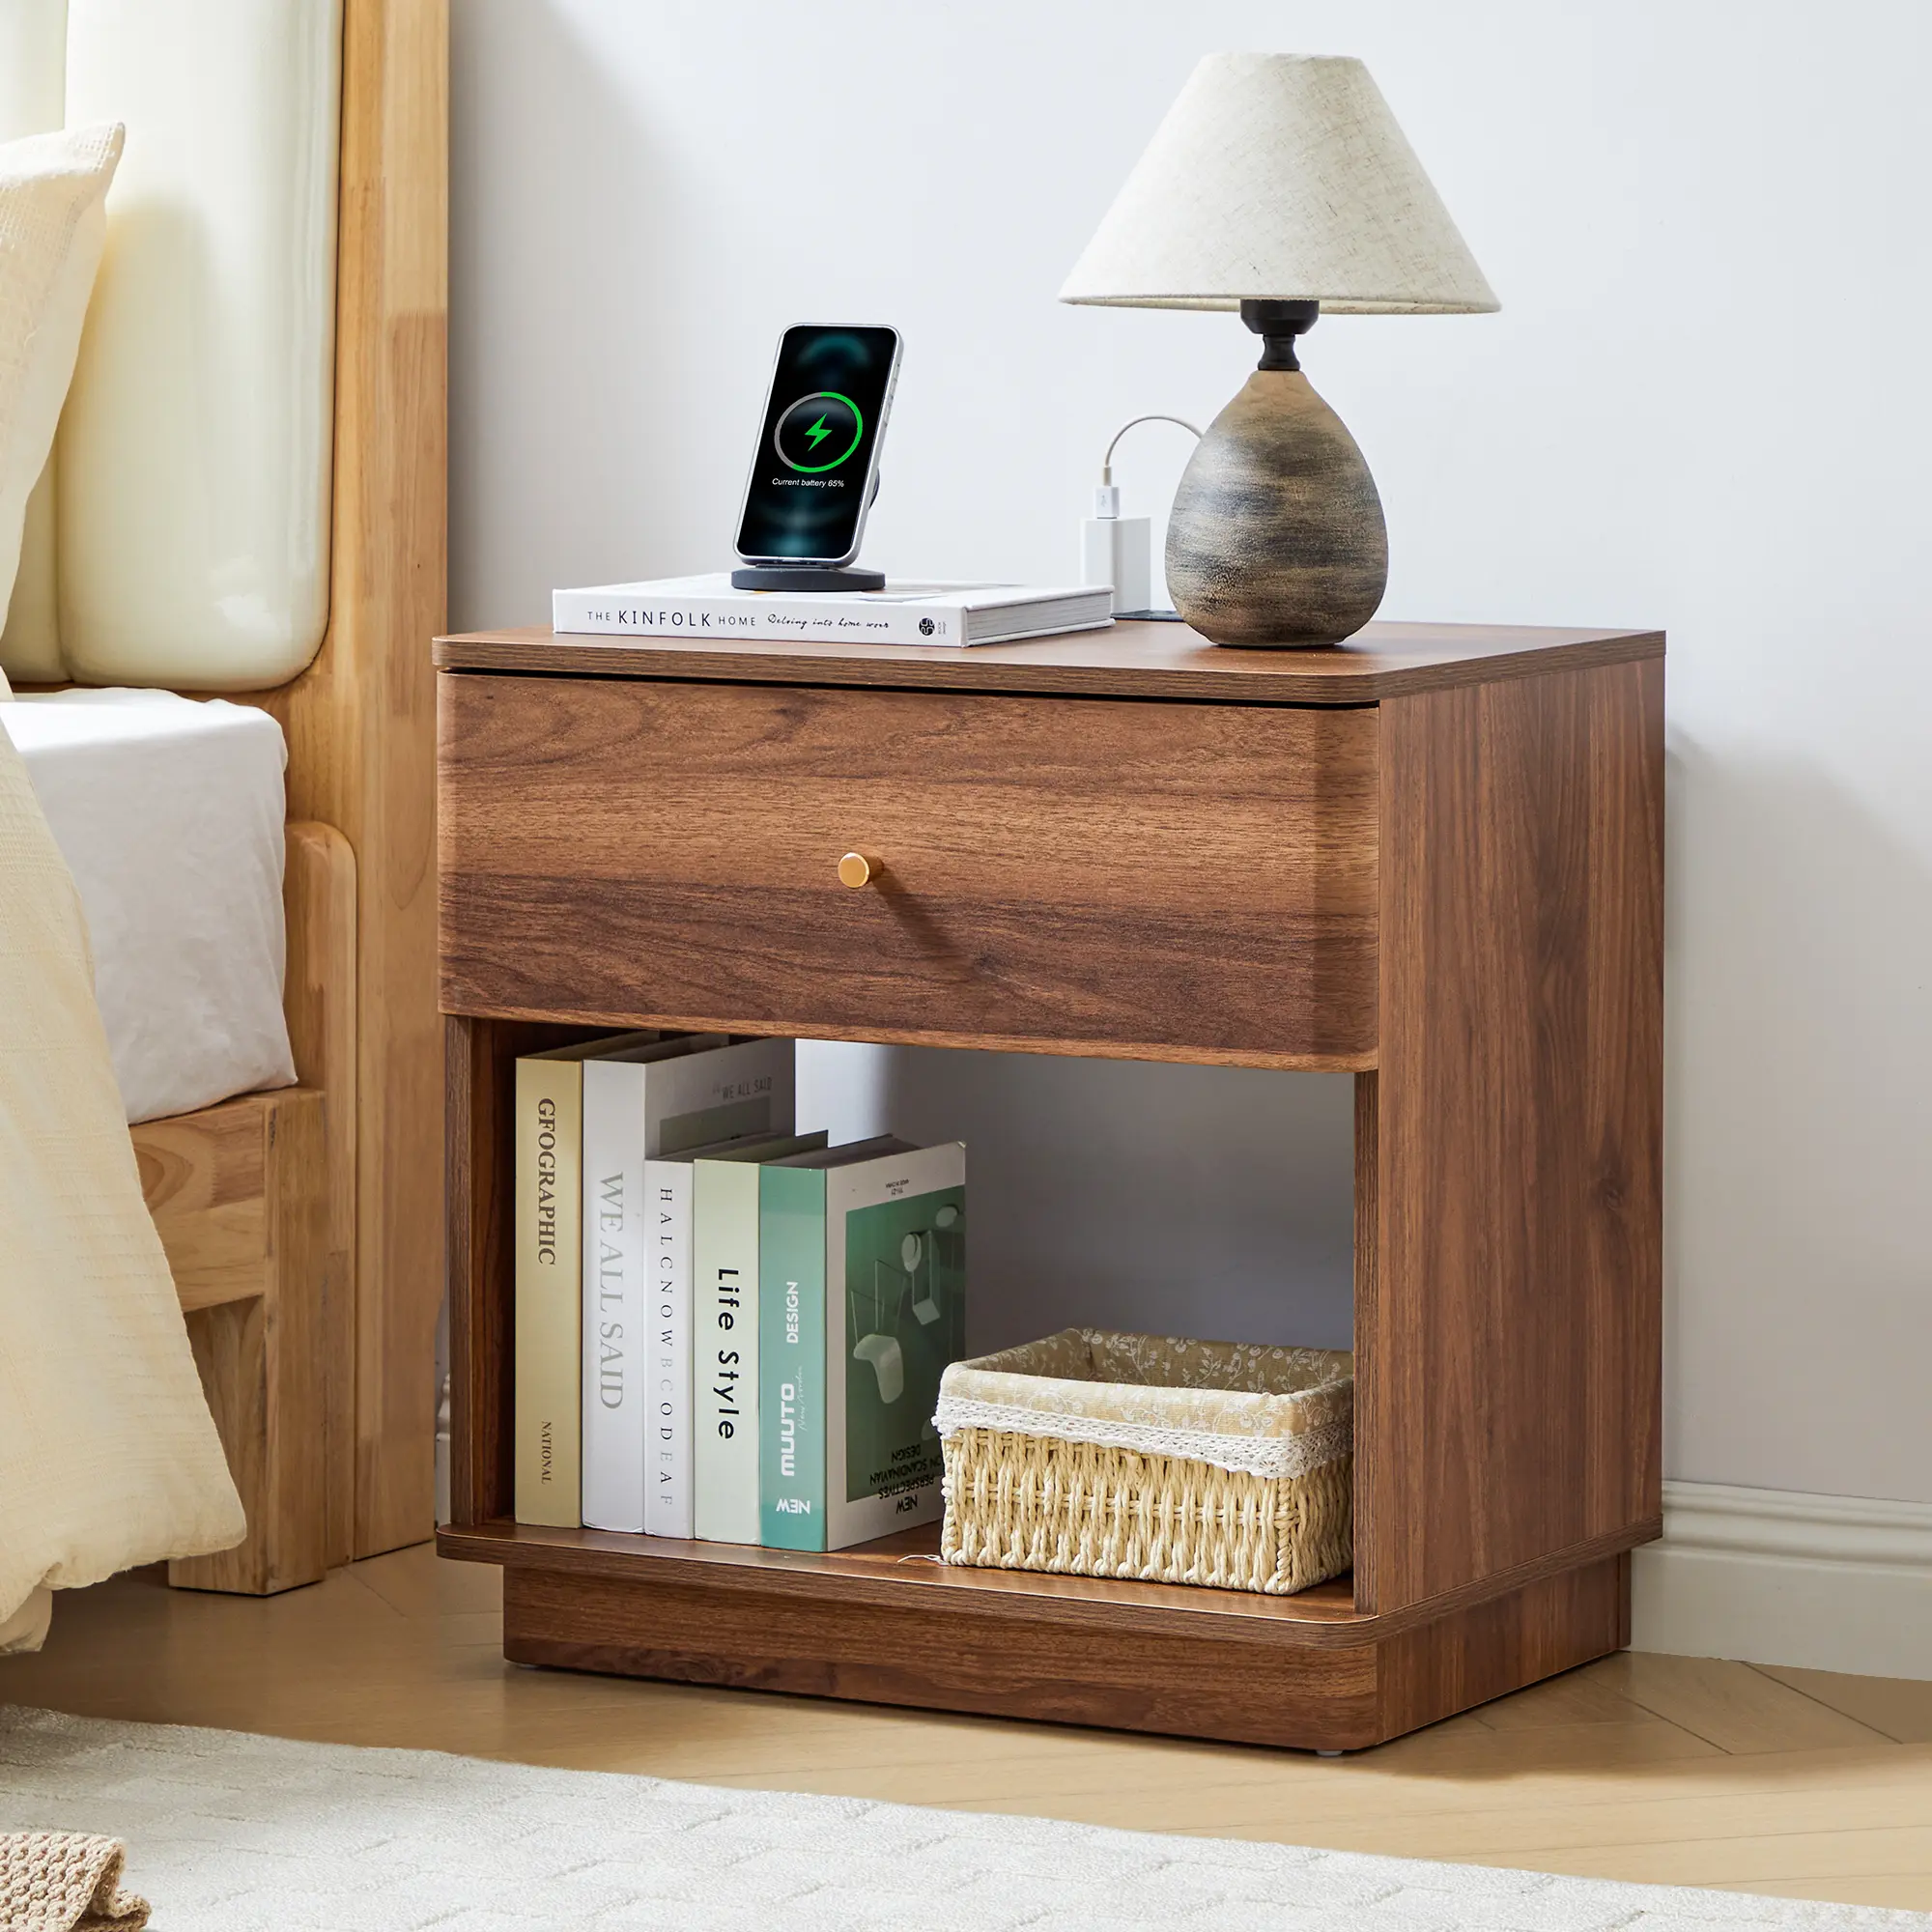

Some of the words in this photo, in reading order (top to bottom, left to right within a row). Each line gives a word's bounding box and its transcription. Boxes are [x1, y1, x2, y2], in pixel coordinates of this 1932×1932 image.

[772, 477, 800, 486] Current
[801, 479, 826, 488] battery
[828, 479, 844, 488] 65%
[587, 611, 611, 621] THE
[618, 610, 711, 627] KINFOLK
[718, 615, 756, 626] HOME
[838, 617, 862, 627] home
[753, 1076, 773, 1094] SAID
[537, 1097, 556, 1265] GFOGRAPHIC
[599, 1171, 624, 1233] WE
[599, 1238, 624, 1313] ALL
[718, 1268, 740, 1330] Life
[785, 1281, 799, 1344] DESIGN
[599, 1321, 624, 1410] SAID
[712, 1350, 740, 1439] Style
[541, 1420, 553, 1486] NATIONAL
[869, 1458, 927, 1486] SCANDINAVIAN
[891, 1443, 921, 1463] DESIGN
[776, 1498, 810, 1515] NEW
[878, 1473, 935, 1500] PERSPECTIVES
[895, 1493, 918, 1515] NEW
